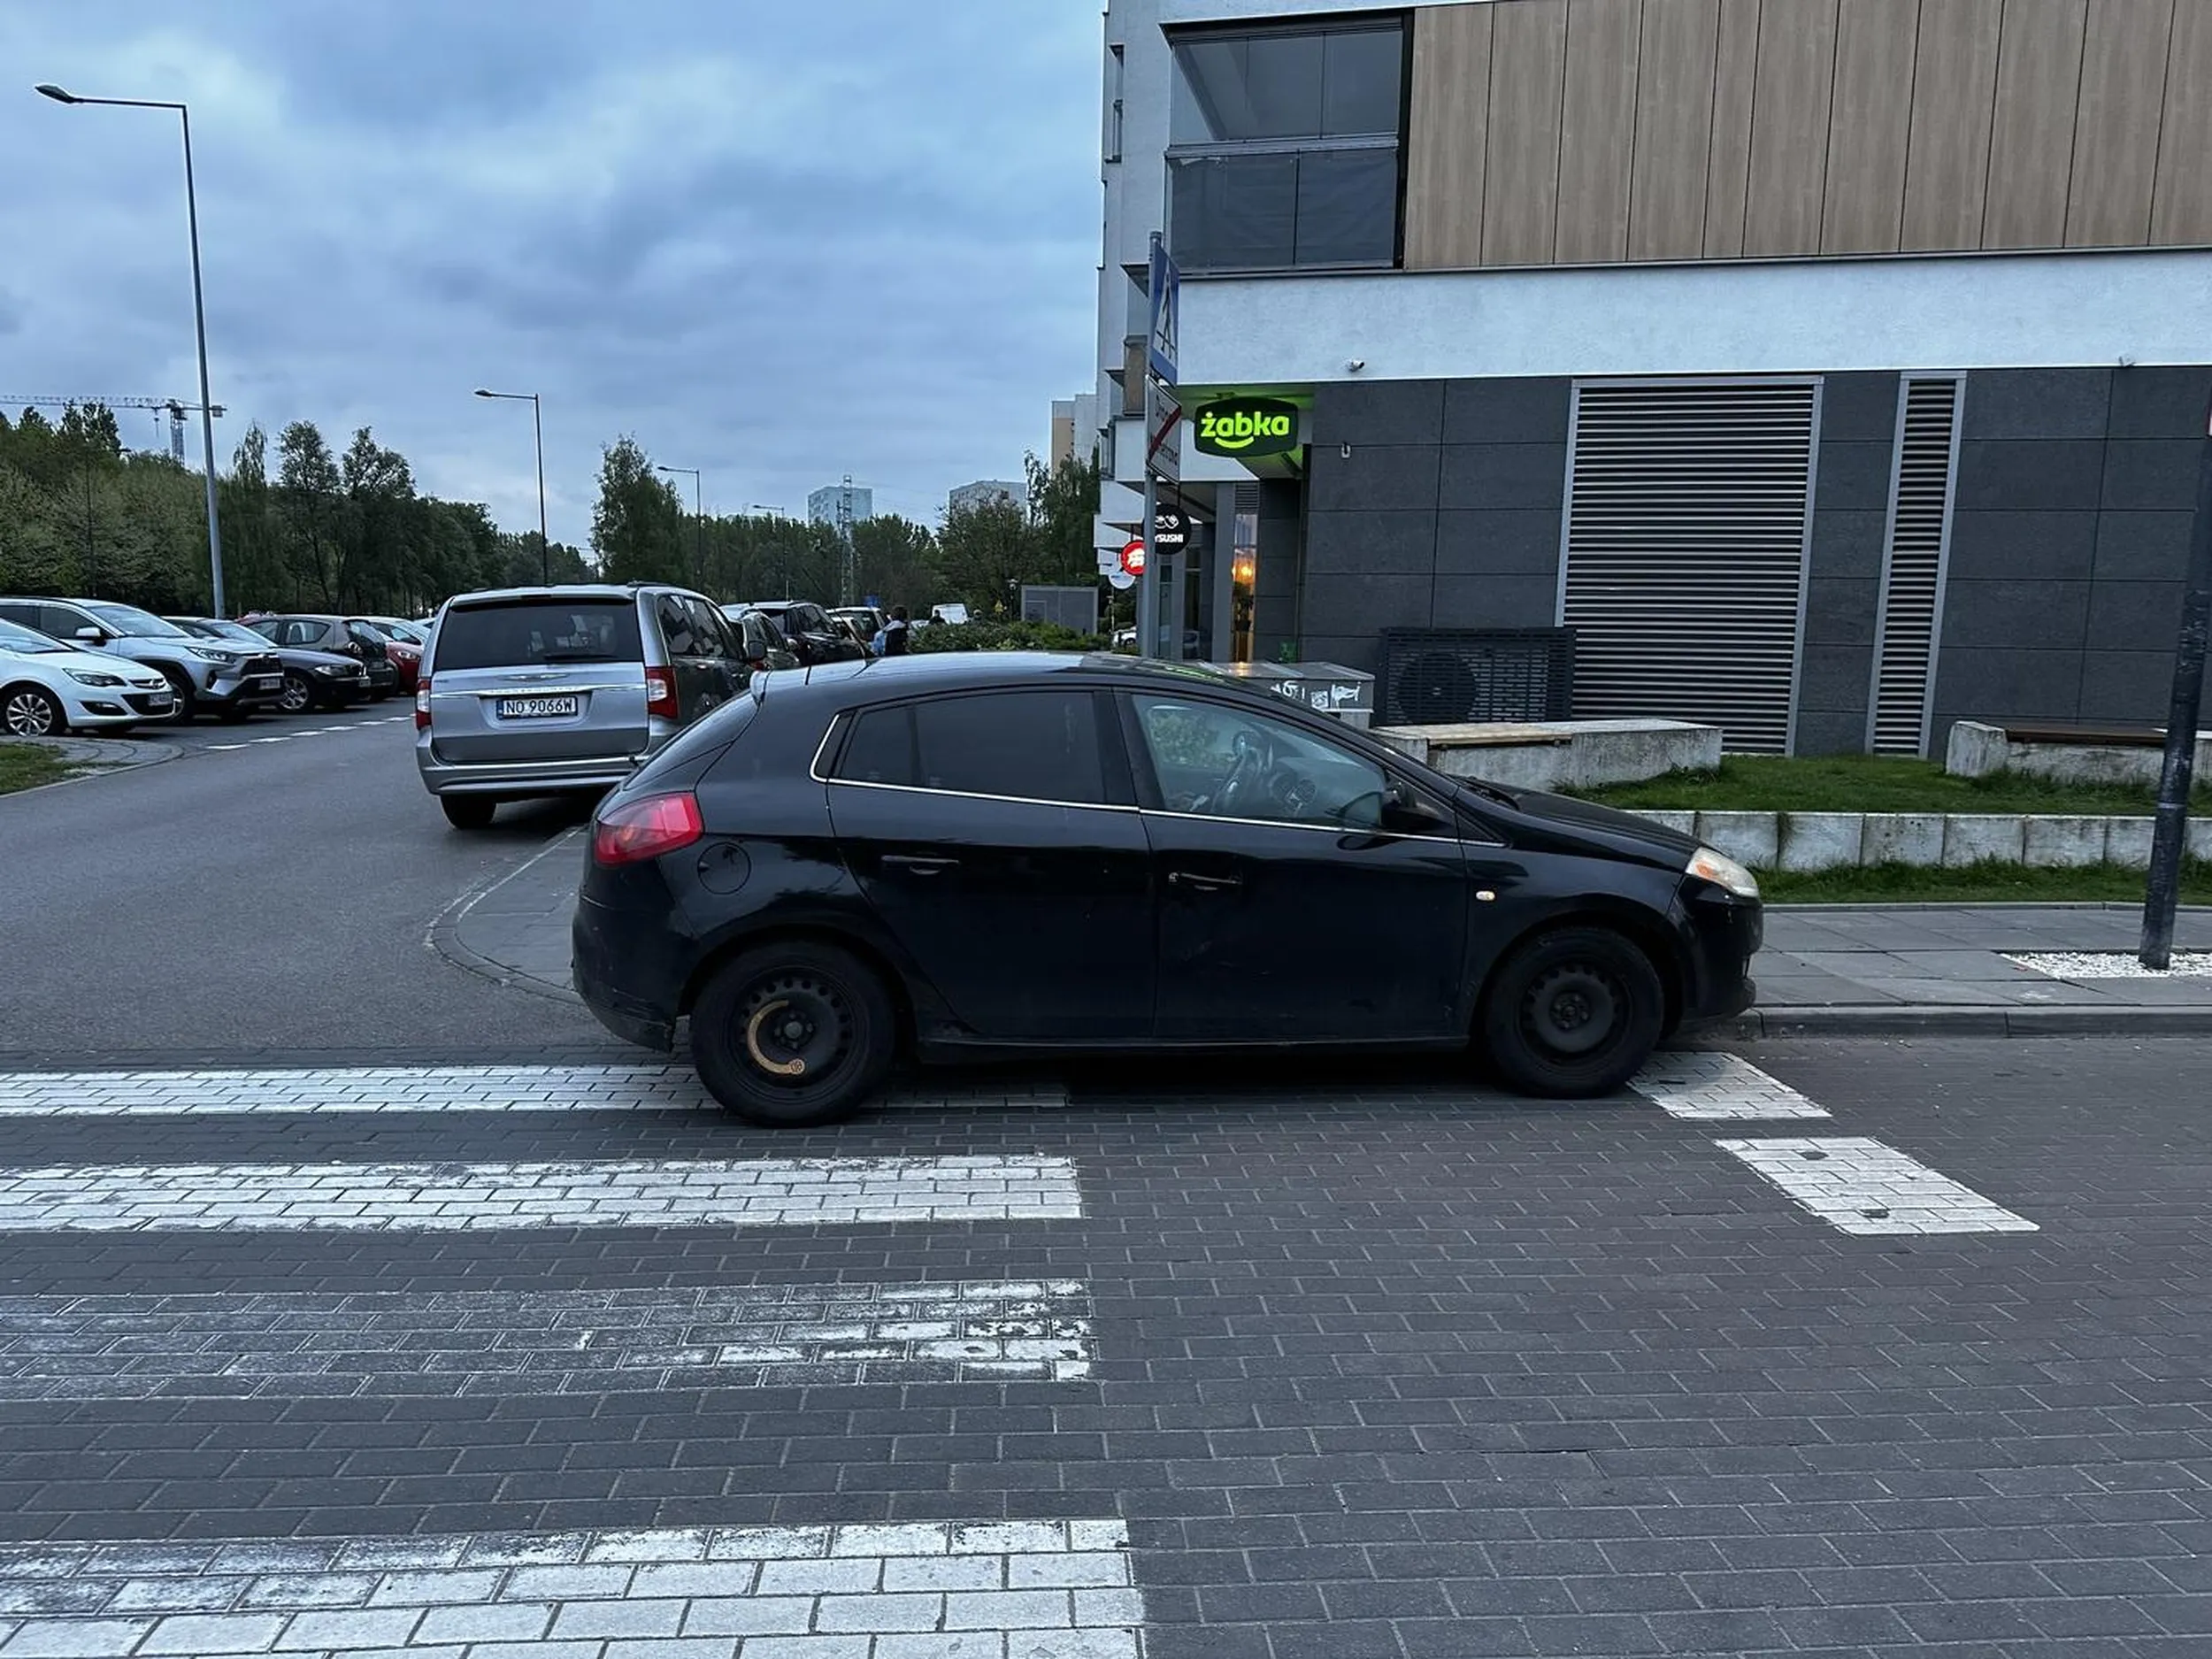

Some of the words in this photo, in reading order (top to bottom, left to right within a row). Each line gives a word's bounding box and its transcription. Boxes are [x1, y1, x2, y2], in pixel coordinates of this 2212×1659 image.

[1201, 411, 1289, 437] żabka
[506, 700, 525, 714] NO
[529, 698, 572, 712] 9066W
